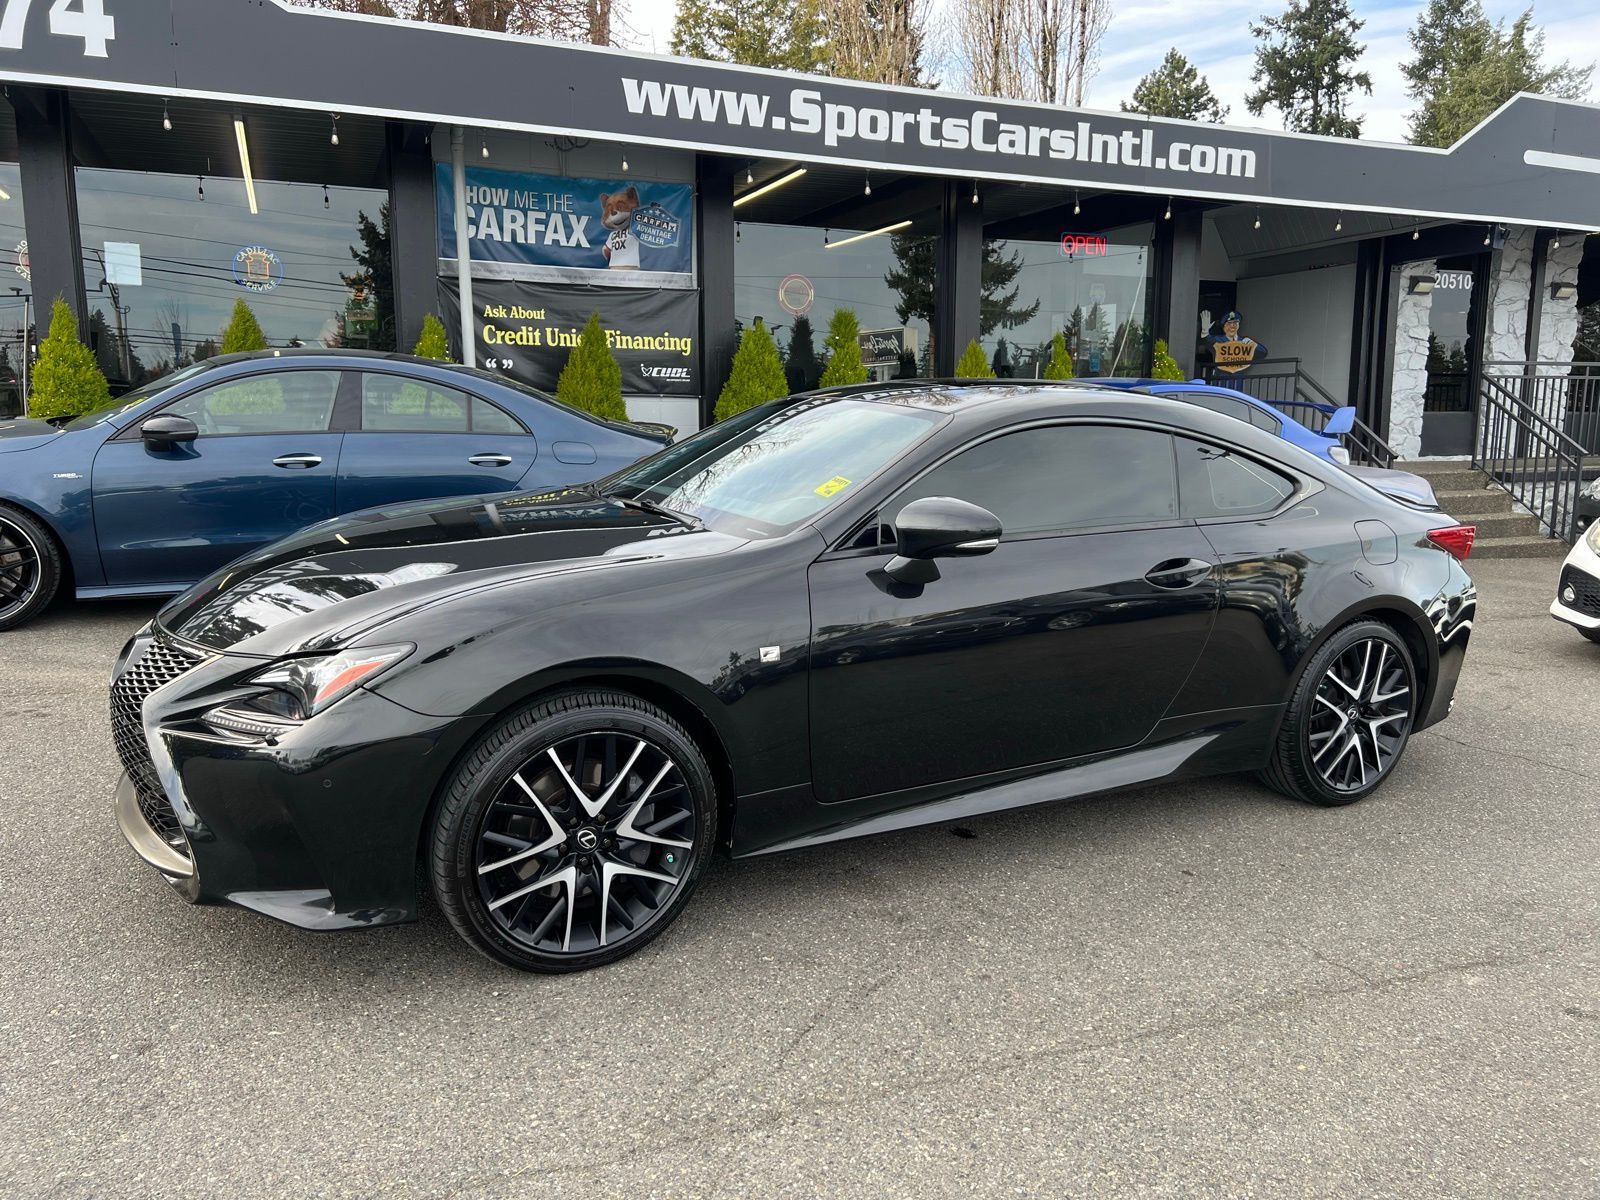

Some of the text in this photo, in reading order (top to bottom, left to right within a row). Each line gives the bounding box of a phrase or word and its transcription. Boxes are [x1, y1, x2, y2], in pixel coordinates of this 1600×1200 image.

[621, 77, 1256, 178] www.SportsCarsIntl.com
[465, 185, 573, 213] HOW ME THE
[454, 205, 591, 248] CARFAX
[635, 214, 677, 232] CARFAX
[611, 229, 628, 241] CAR
[636, 224, 672, 240] ADVANTAGE
[640, 233, 665, 245] DEALER
[611, 240, 626, 250] FOX
[1062, 235, 1106, 256] OPEN
[1434, 273, 1472, 289] 20510
[484, 304, 545, 320] Ask About
[483, 325, 541, 346] Credit
[605, 329, 691, 356] Financing
[1220, 345, 1252, 356] SLOW
